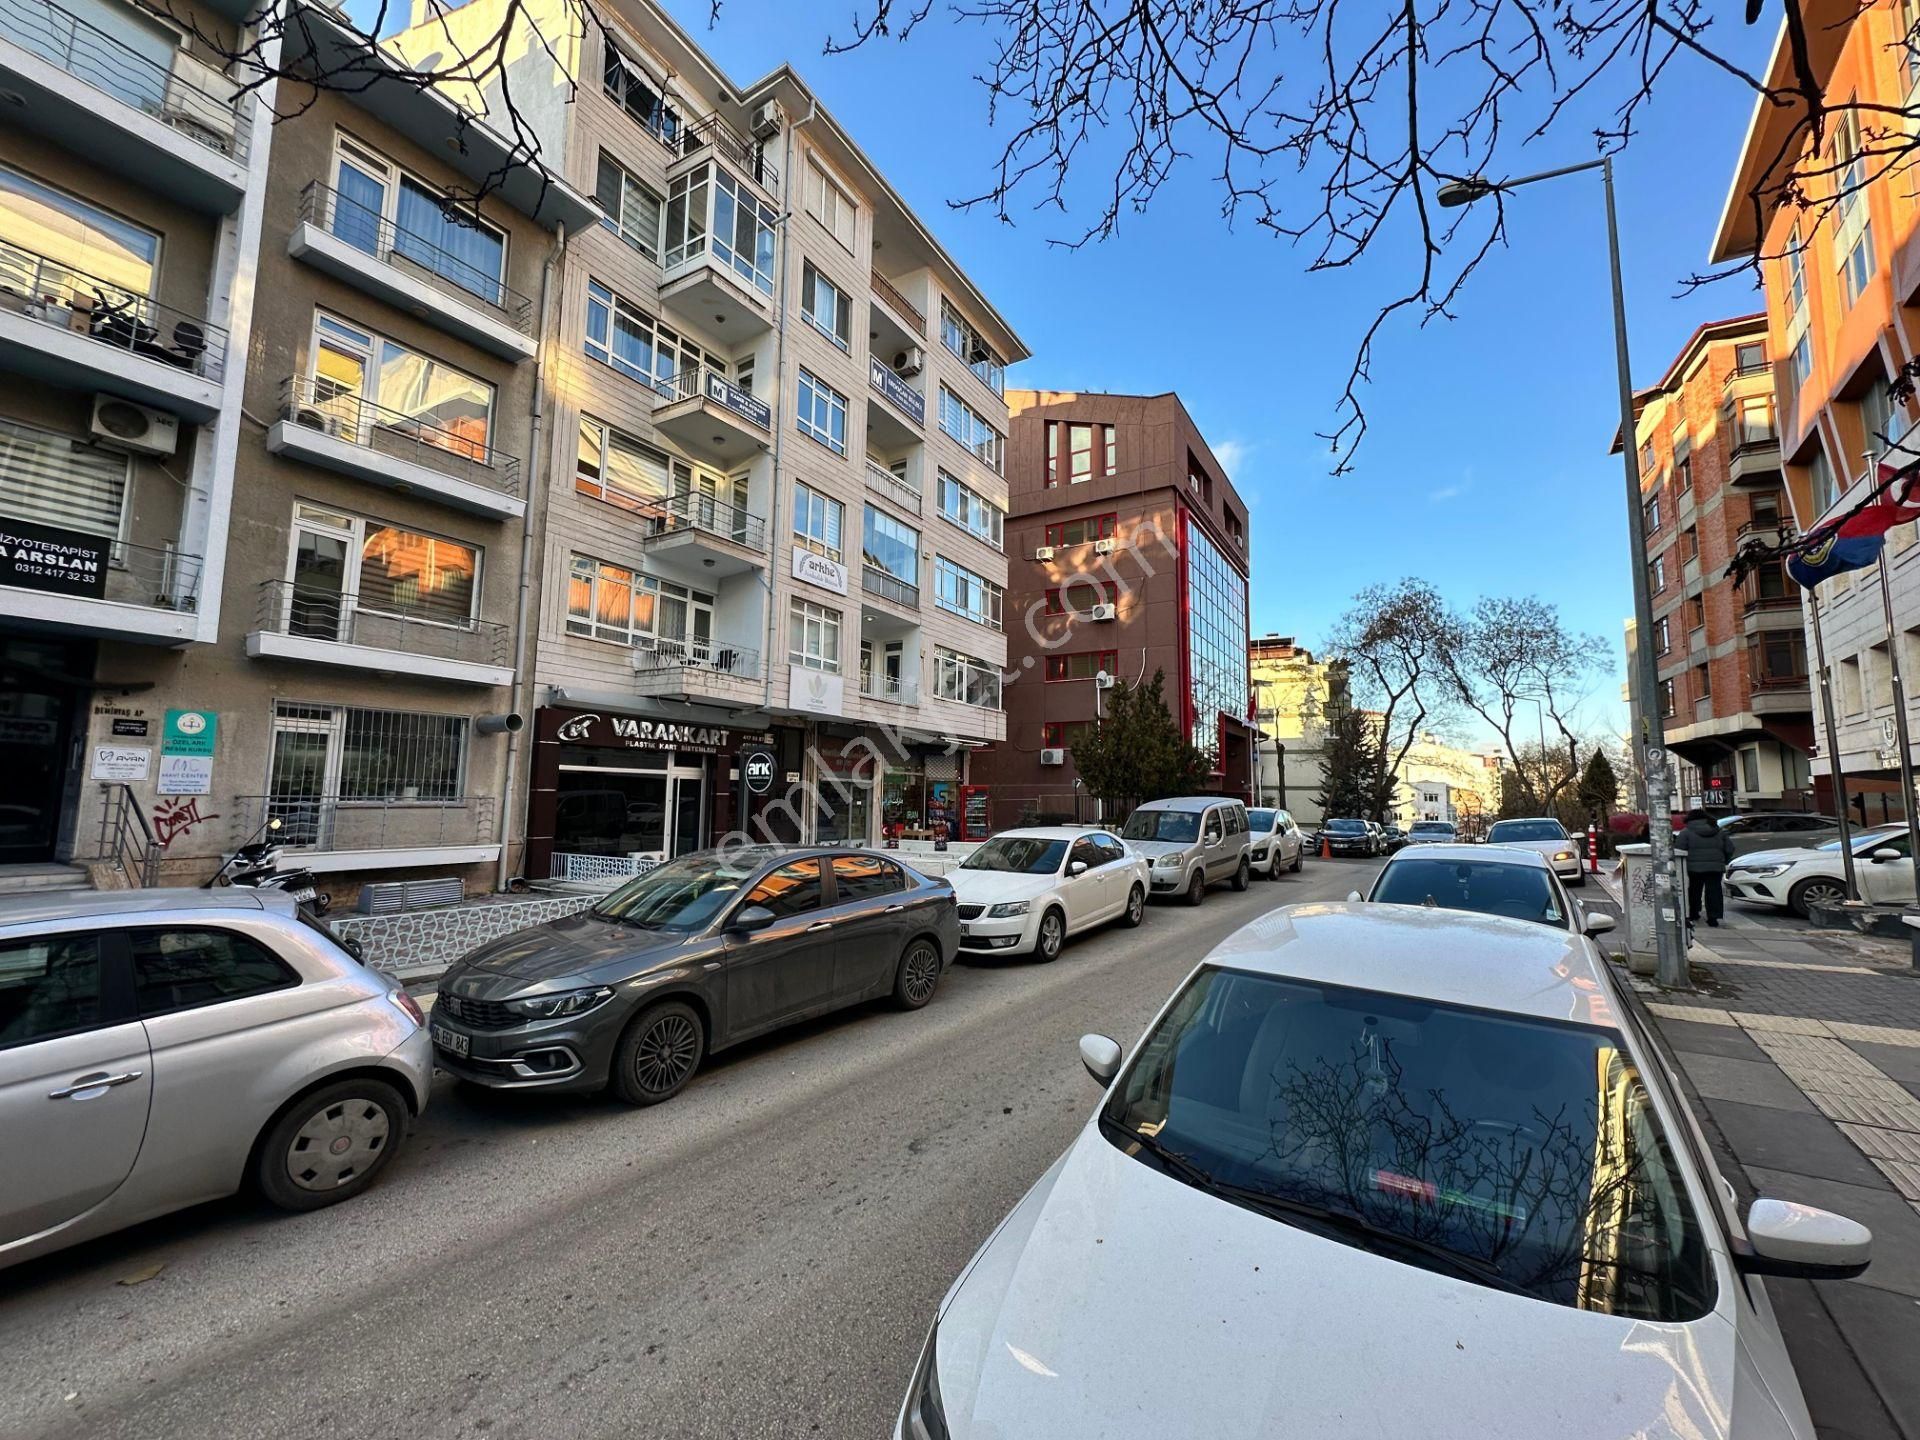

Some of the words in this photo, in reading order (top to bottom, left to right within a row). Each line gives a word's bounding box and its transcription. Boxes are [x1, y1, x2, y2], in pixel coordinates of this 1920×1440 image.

[0, 533, 99, 560] İZYOTERAPİST
[14, 549, 98, 572] ARSLAN
[809, 561, 835, 577] arkhe
[15, 563, 43, 575] 0312
[45, 568, 65, 578] 417
[67, 571, 80, 581] 32
[82, 574, 96, 583] 33
[611, 717, 730, 746] VARANKART
[659, 743, 678, 751] KART
